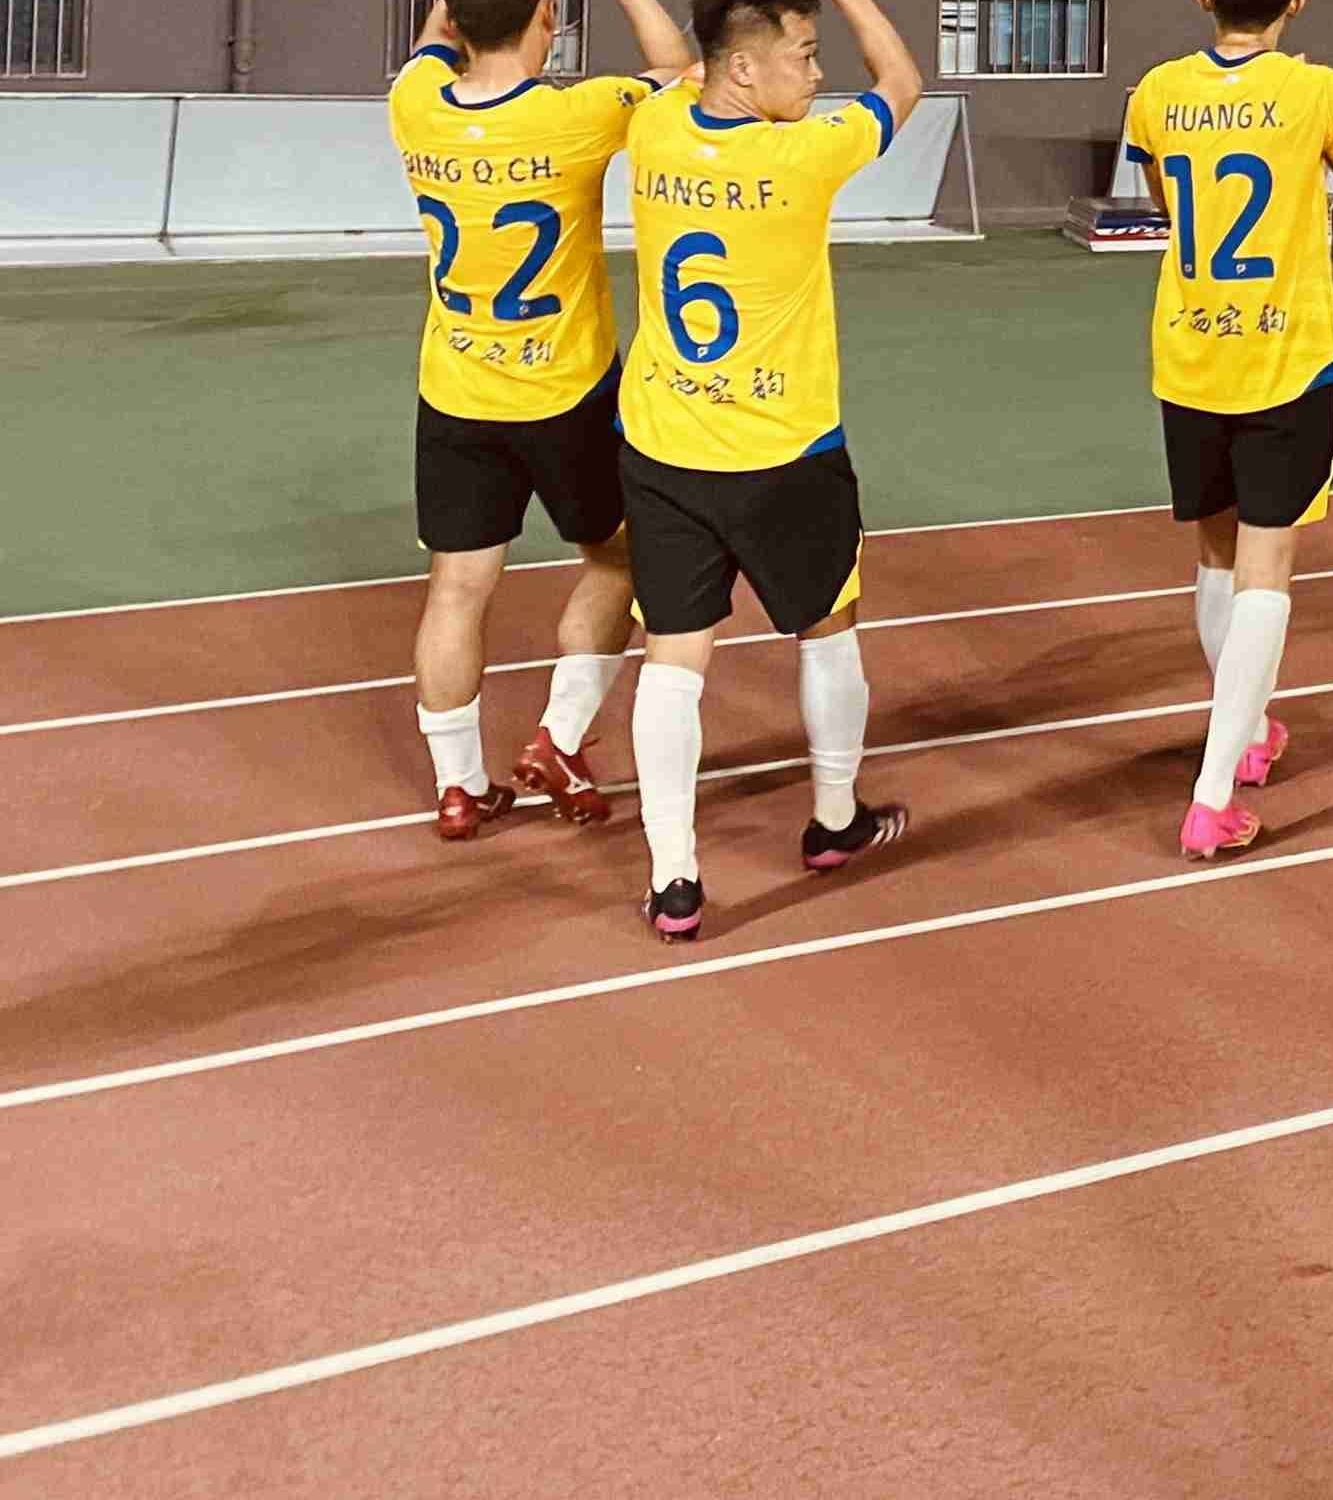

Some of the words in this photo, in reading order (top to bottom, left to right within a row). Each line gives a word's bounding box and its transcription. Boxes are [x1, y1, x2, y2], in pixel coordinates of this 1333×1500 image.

[1164, 101, 1253, 132] HUANG
[1259, 100, 1284, 129] X.
[634, 164, 716, 208] LIANG
[726, 179, 788, 210] R.F.
[1163, 153, 1275, 281] 12
[416, 194, 563, 321] 22
[662, 231, 739, 363] 6
